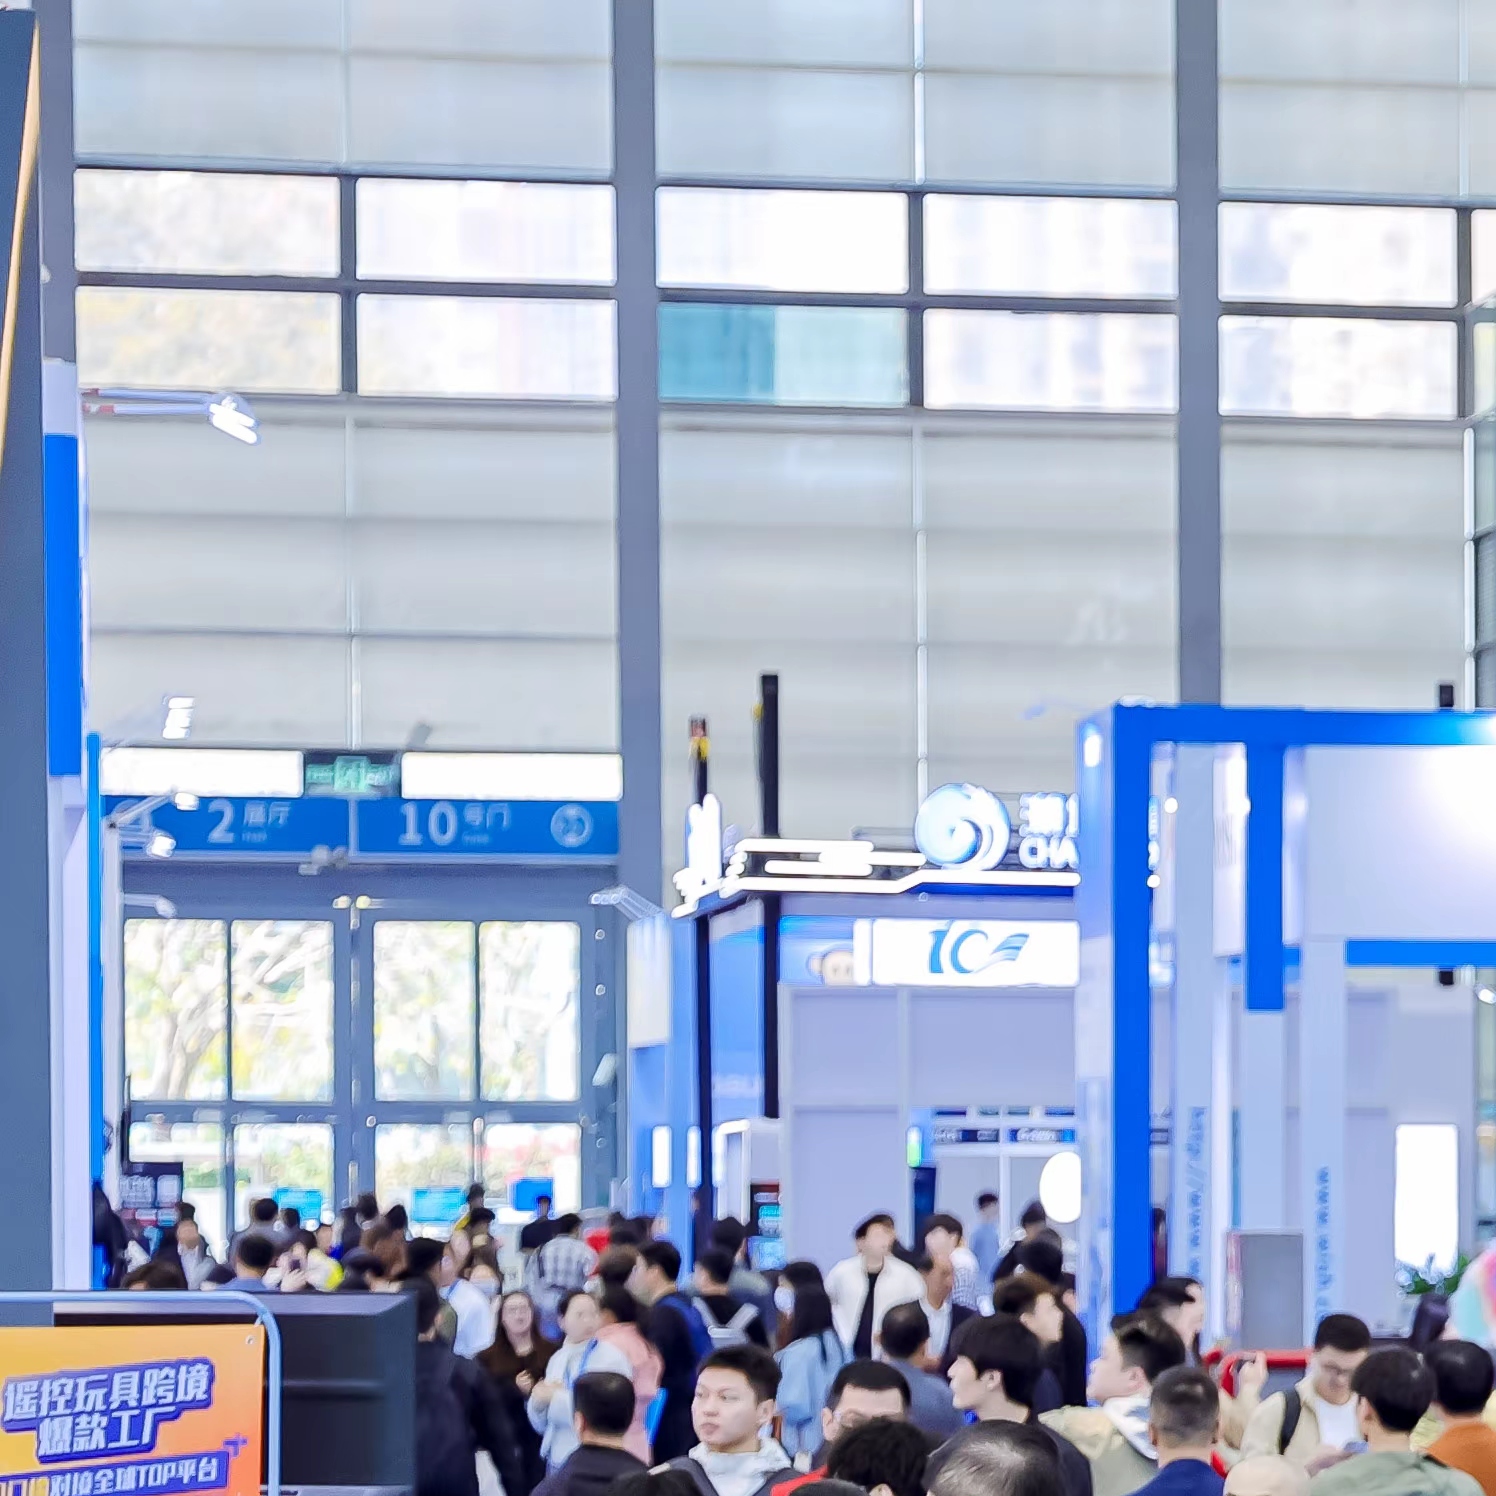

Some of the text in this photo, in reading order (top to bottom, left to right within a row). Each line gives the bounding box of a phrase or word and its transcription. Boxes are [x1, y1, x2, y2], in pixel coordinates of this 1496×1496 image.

[3, 1362, 211, 1422] 遥控玩具跨境
